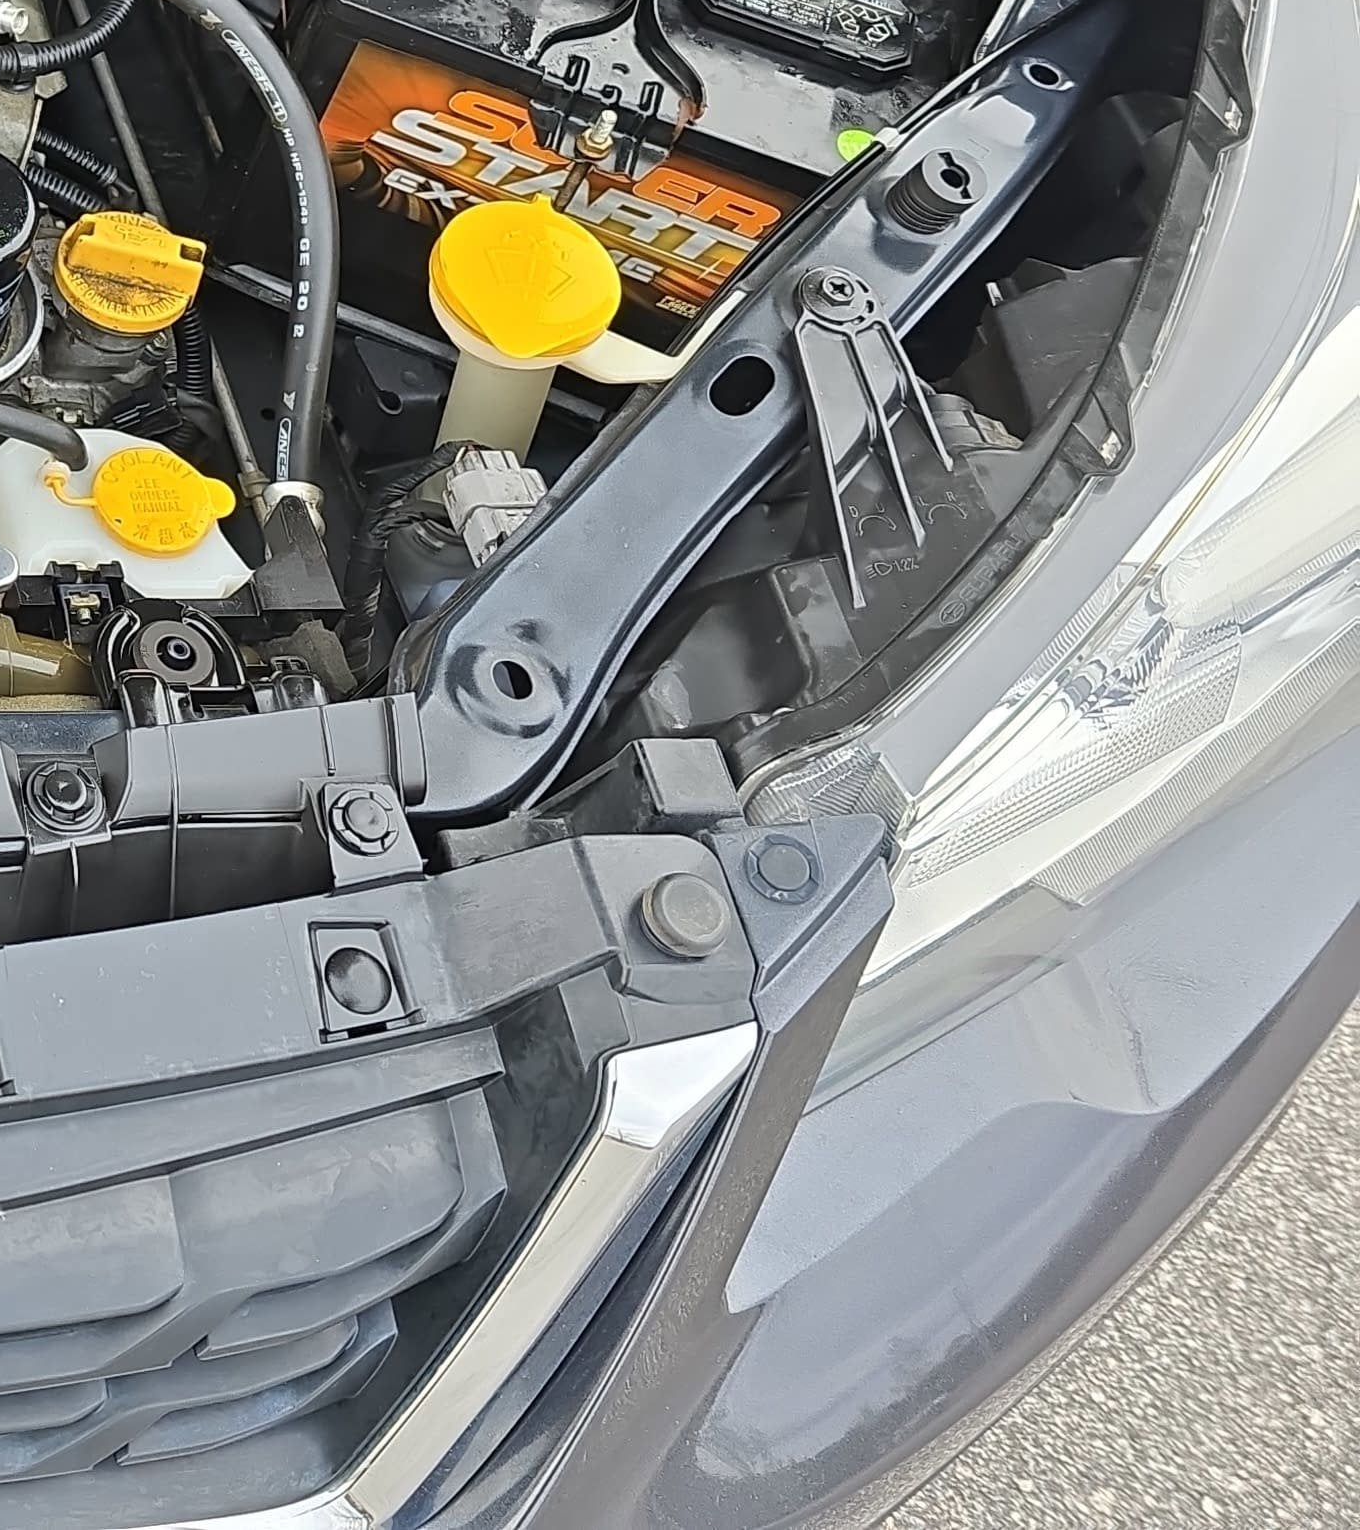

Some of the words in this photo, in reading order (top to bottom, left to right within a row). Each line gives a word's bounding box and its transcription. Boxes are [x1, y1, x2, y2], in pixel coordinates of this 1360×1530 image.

[282, 127, 295, 147] HP
[433, 90, 781, 238] SUER
[371, 108, 761, 262] START
[299, 237, 310, 266] GE
[297, 280, 310, 311] 20
[101, 451, 195, 484] COOLANT
